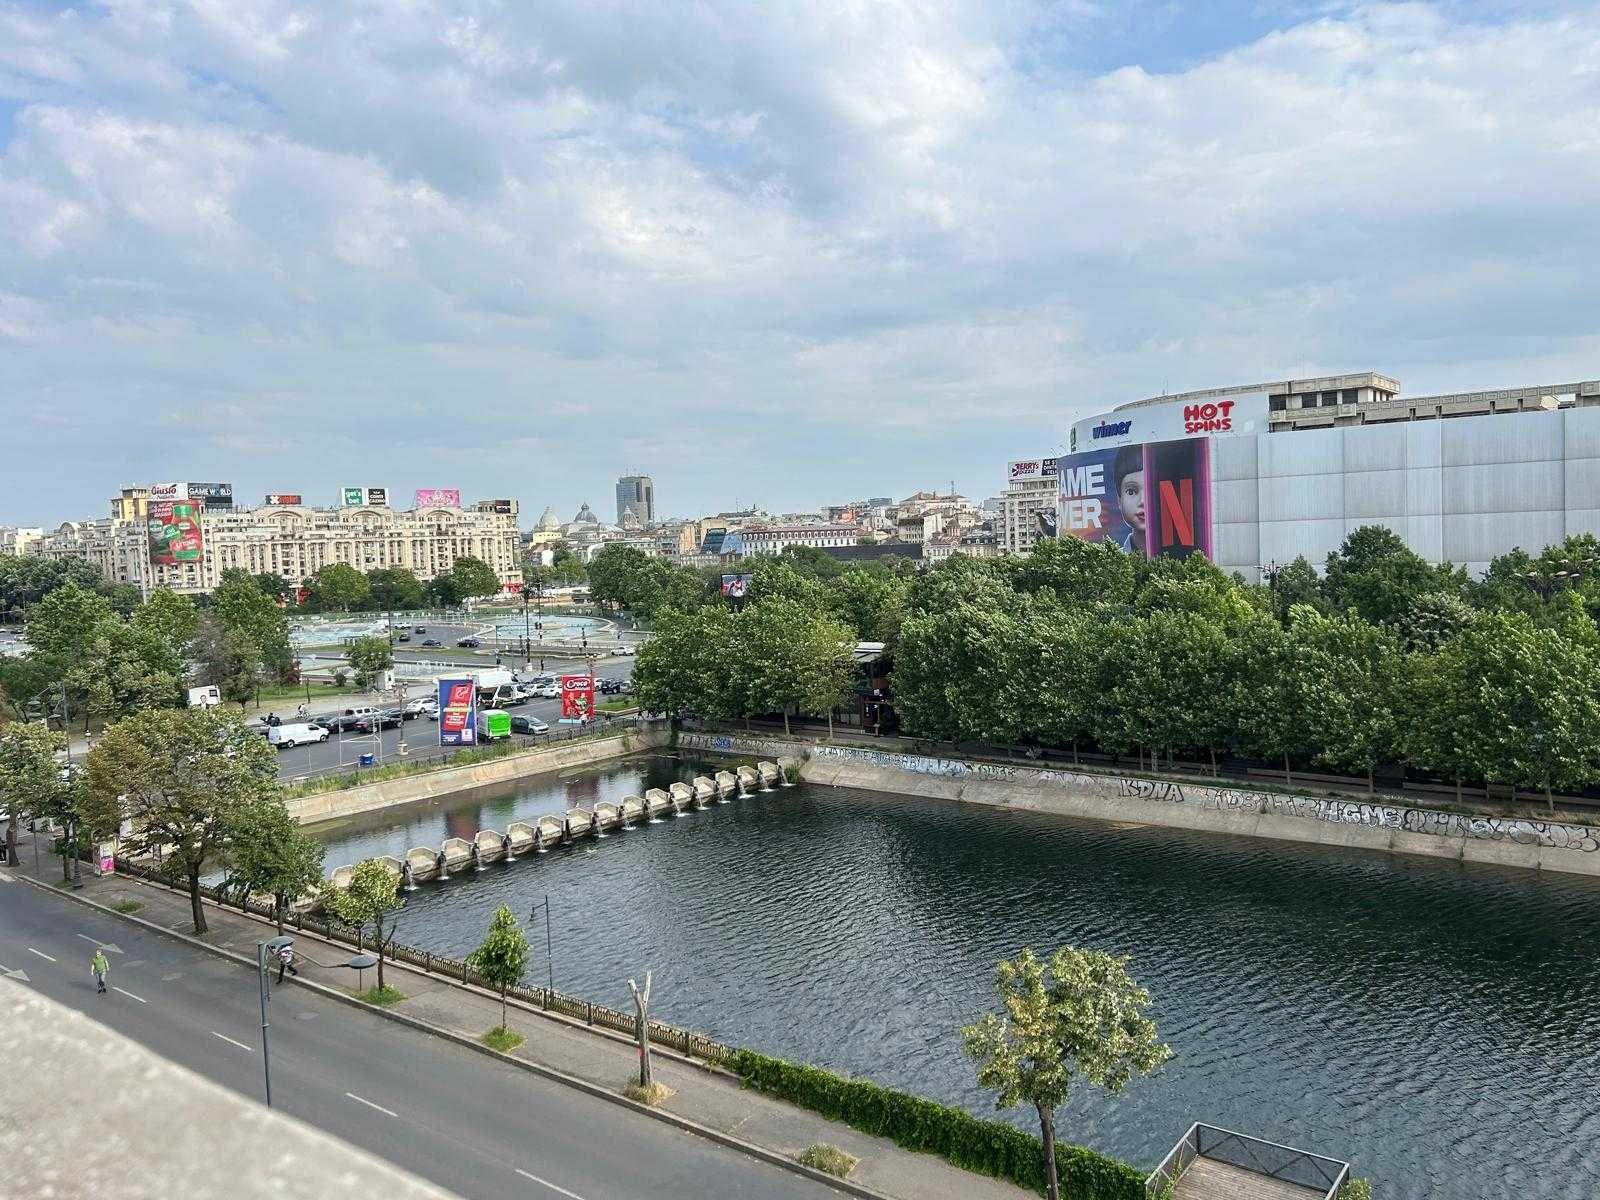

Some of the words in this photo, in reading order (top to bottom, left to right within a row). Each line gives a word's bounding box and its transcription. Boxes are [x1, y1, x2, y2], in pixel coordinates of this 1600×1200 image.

[1184, 401, 1235, 421] HOT
[1092, 420, 1132, 439] winner
[1185, 418, 1232, 434] SPINS
[1060, 464, 1106, 498] AME
[1159, 479, 1195, 547] N
